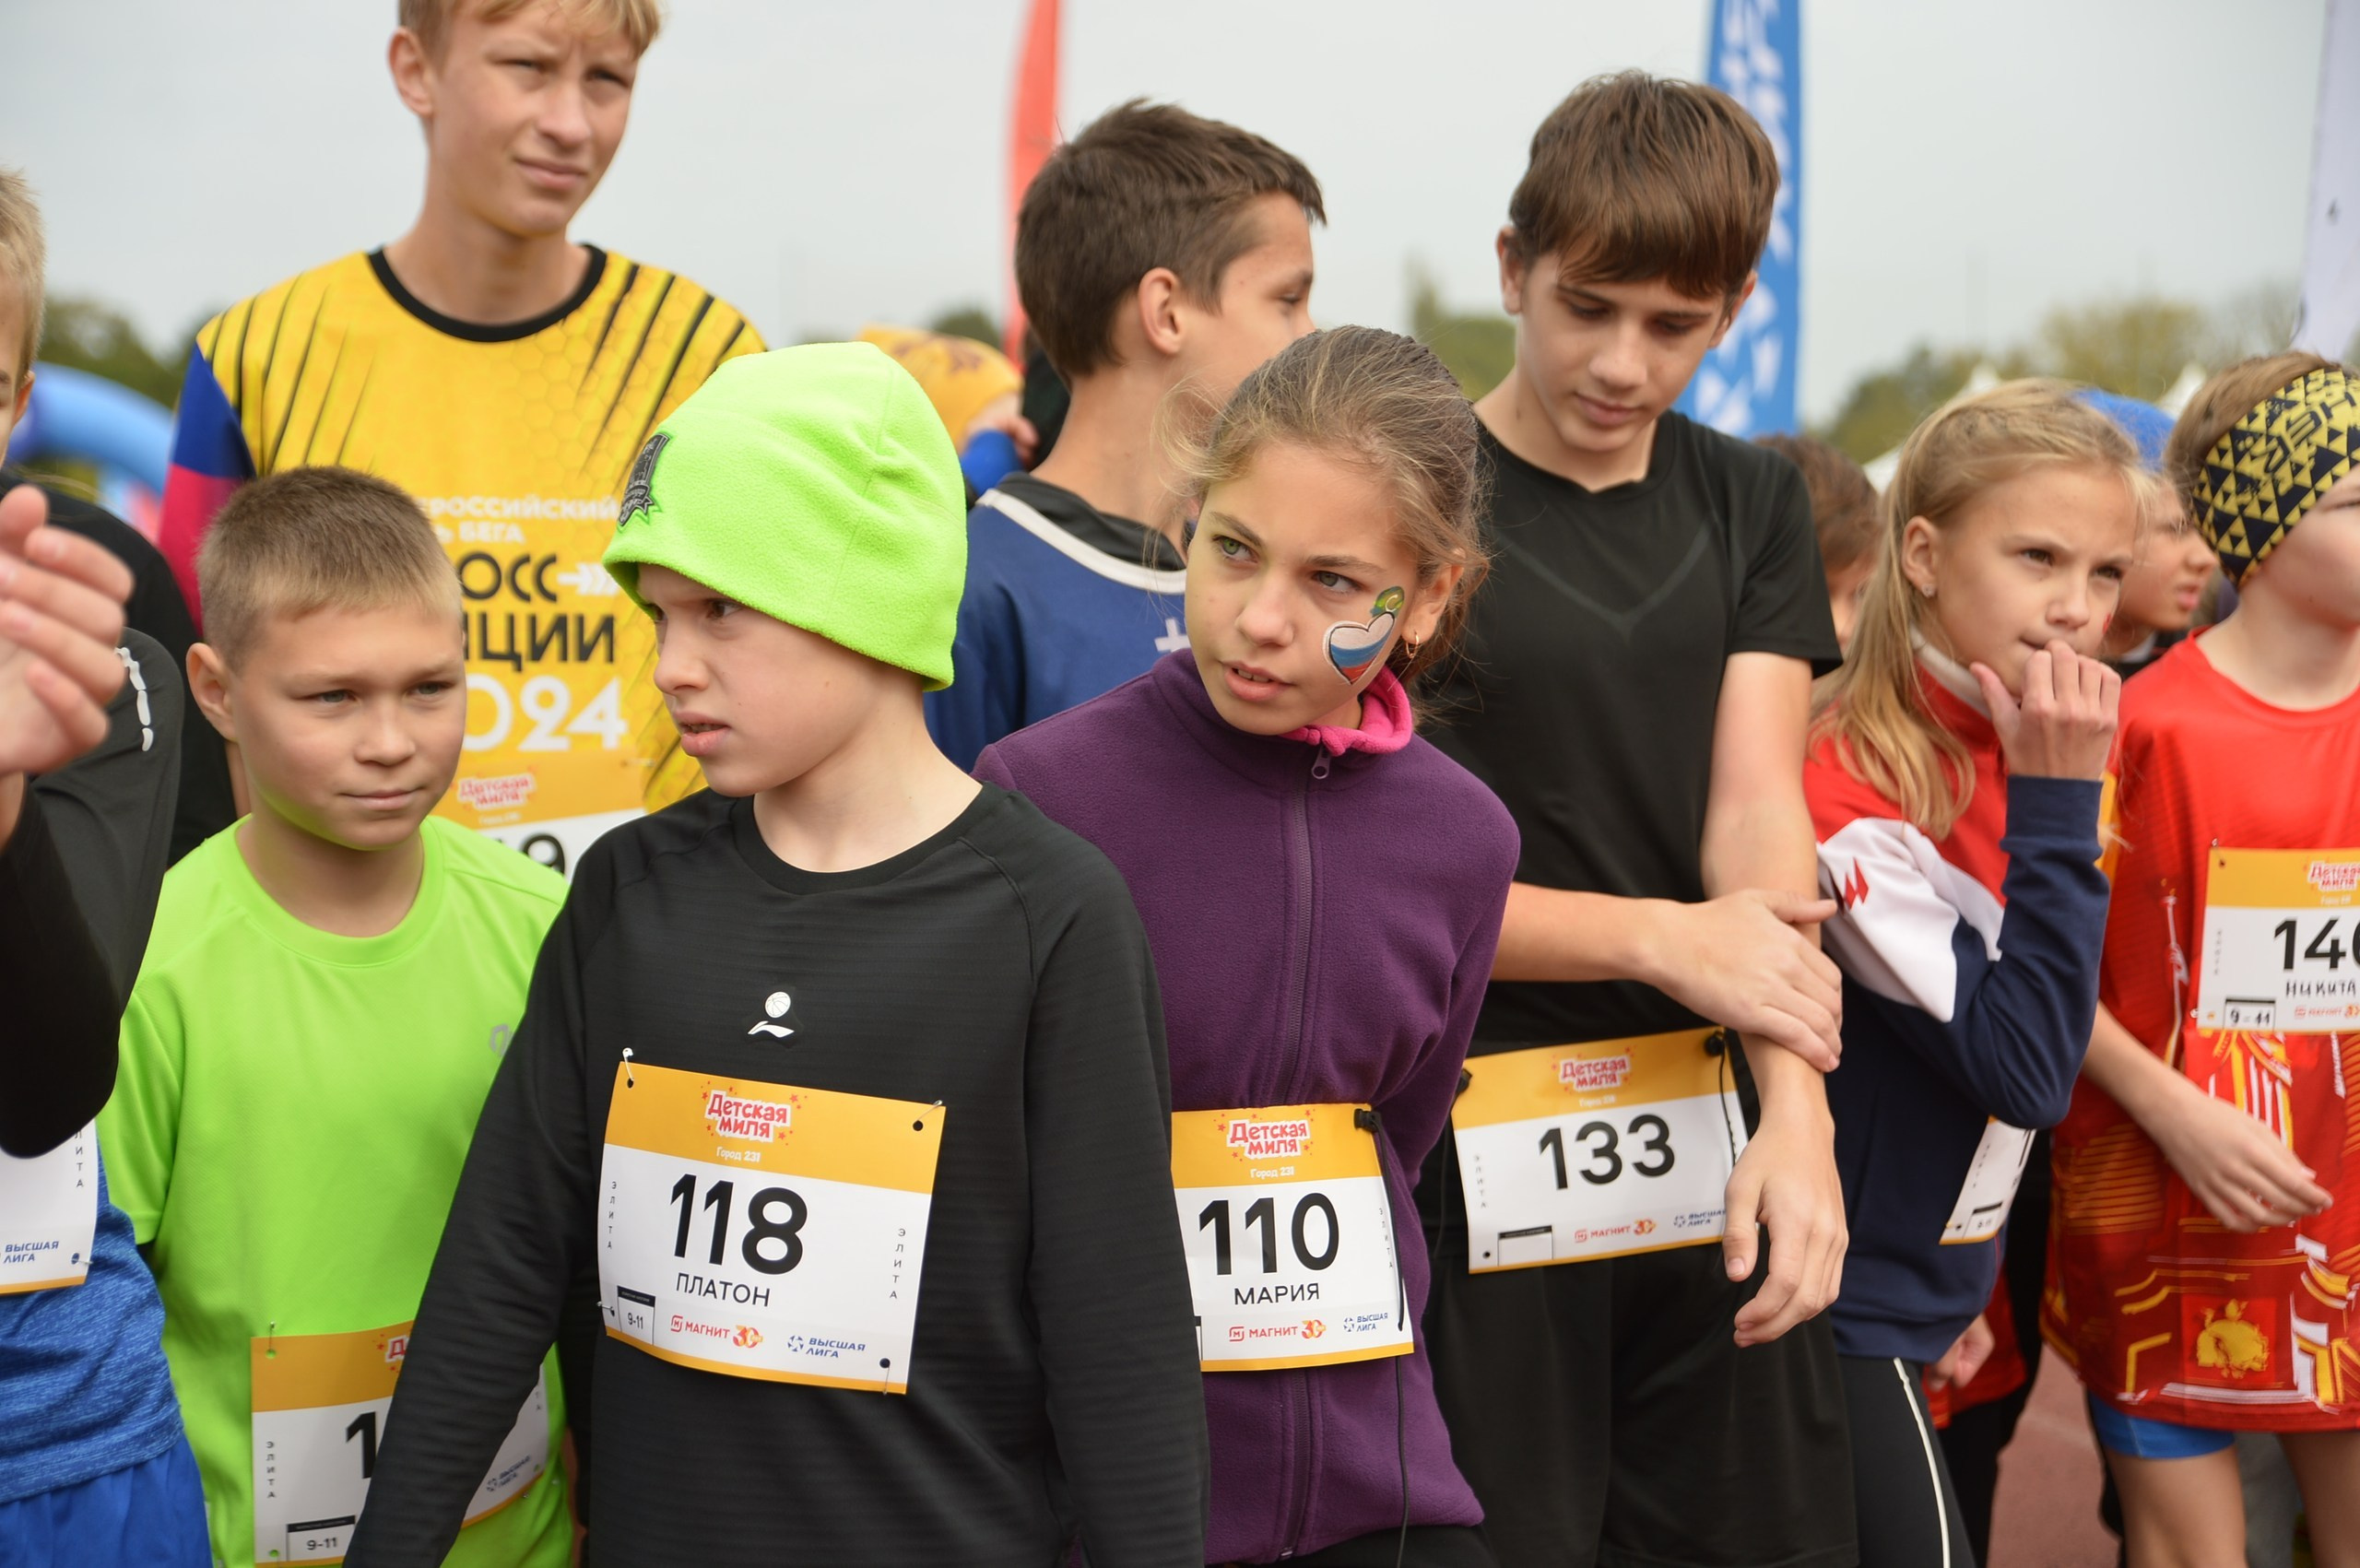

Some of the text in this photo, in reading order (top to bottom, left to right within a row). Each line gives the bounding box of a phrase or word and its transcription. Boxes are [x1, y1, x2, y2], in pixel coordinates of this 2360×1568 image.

[460, 521, 526, 546] БЕГА
[465, 612, 615, 673] ЦИИ
[2274, 917, 2360, 972] 14
[2285, 980, 2356, 997] НИКИТА
[1563, 1057, 1627, 1079] Детская
[1577, 1073, 1618, 1088] миля
[706, 1093, 788, 1124] Детская
[719, 1116, 771, 1138] миля
[1230, 1123, 1307, 1144] Детская
[716, 1146, 761, 1162] Город 231
[1247, 1138, 1298, 1155] миля
[1539, 1114, 1675, 1190] 133
[1250, 1165, 1295, 1179] Город 231
[607, 1181, 618, 1250] ЭЛИТА
[670, 1173, 808, 1275] 118
[1198, 1193, 1339, 1276] 110
[1590, 1226, 1631, 1239] МАГНИТ
[5, 1241, 59, 1253] ВЫСШАЯ
[3, 1253, 35, 1263] ЛИГА
[890, 1228, 906, 1299] ЭЛИТА
[676, 1272, 771, 1307] ПЛАТОН
[1234, 1282, 1320, 1305] МАРИЯ
[627, 1312, 643, 1329] 9-11
[1356, 1312, 1388, 1323] ВЫСШАЯ
[685, 1321, 731, 1338] МАГНИТ
[1248, 1326, 1299, 1338] МАГНИТ
[1355, 1323, 1376, 1332] ЛИГА
[806, 1348, 839, 1358] ЛИГА
[808, 1338, 866, 1351] ВЫСШАЯ
[266, 1441, 276, 1499] ЭЛИТА
[306, 1537, 337, 1550] 9-11
